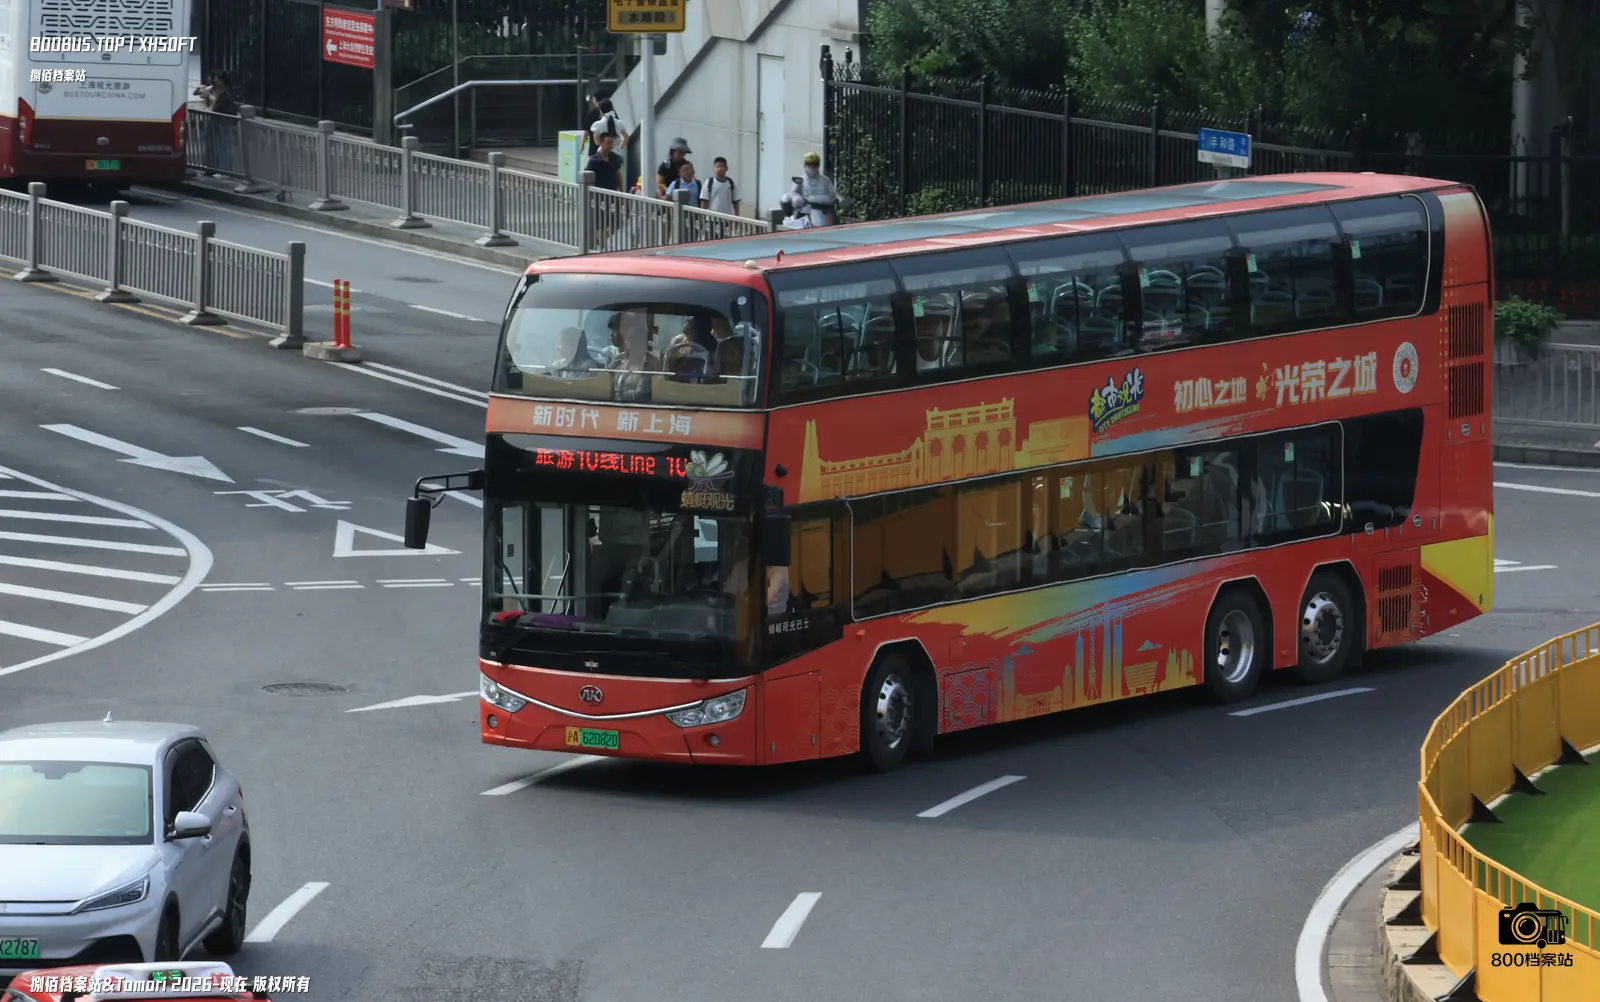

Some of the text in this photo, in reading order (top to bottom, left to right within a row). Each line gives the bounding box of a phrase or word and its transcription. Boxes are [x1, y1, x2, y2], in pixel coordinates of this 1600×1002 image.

[1091, 367, 1144, 419] 都市观光
[1174, 352, 1377, 413] 初心之地 光荣之城
[533, 404, 692, 436] 新时代 新上海
[680, 490, 735, 510] 蜻蜓观光
[768, 617, 810, 635] 蜻蜓观光巴士
